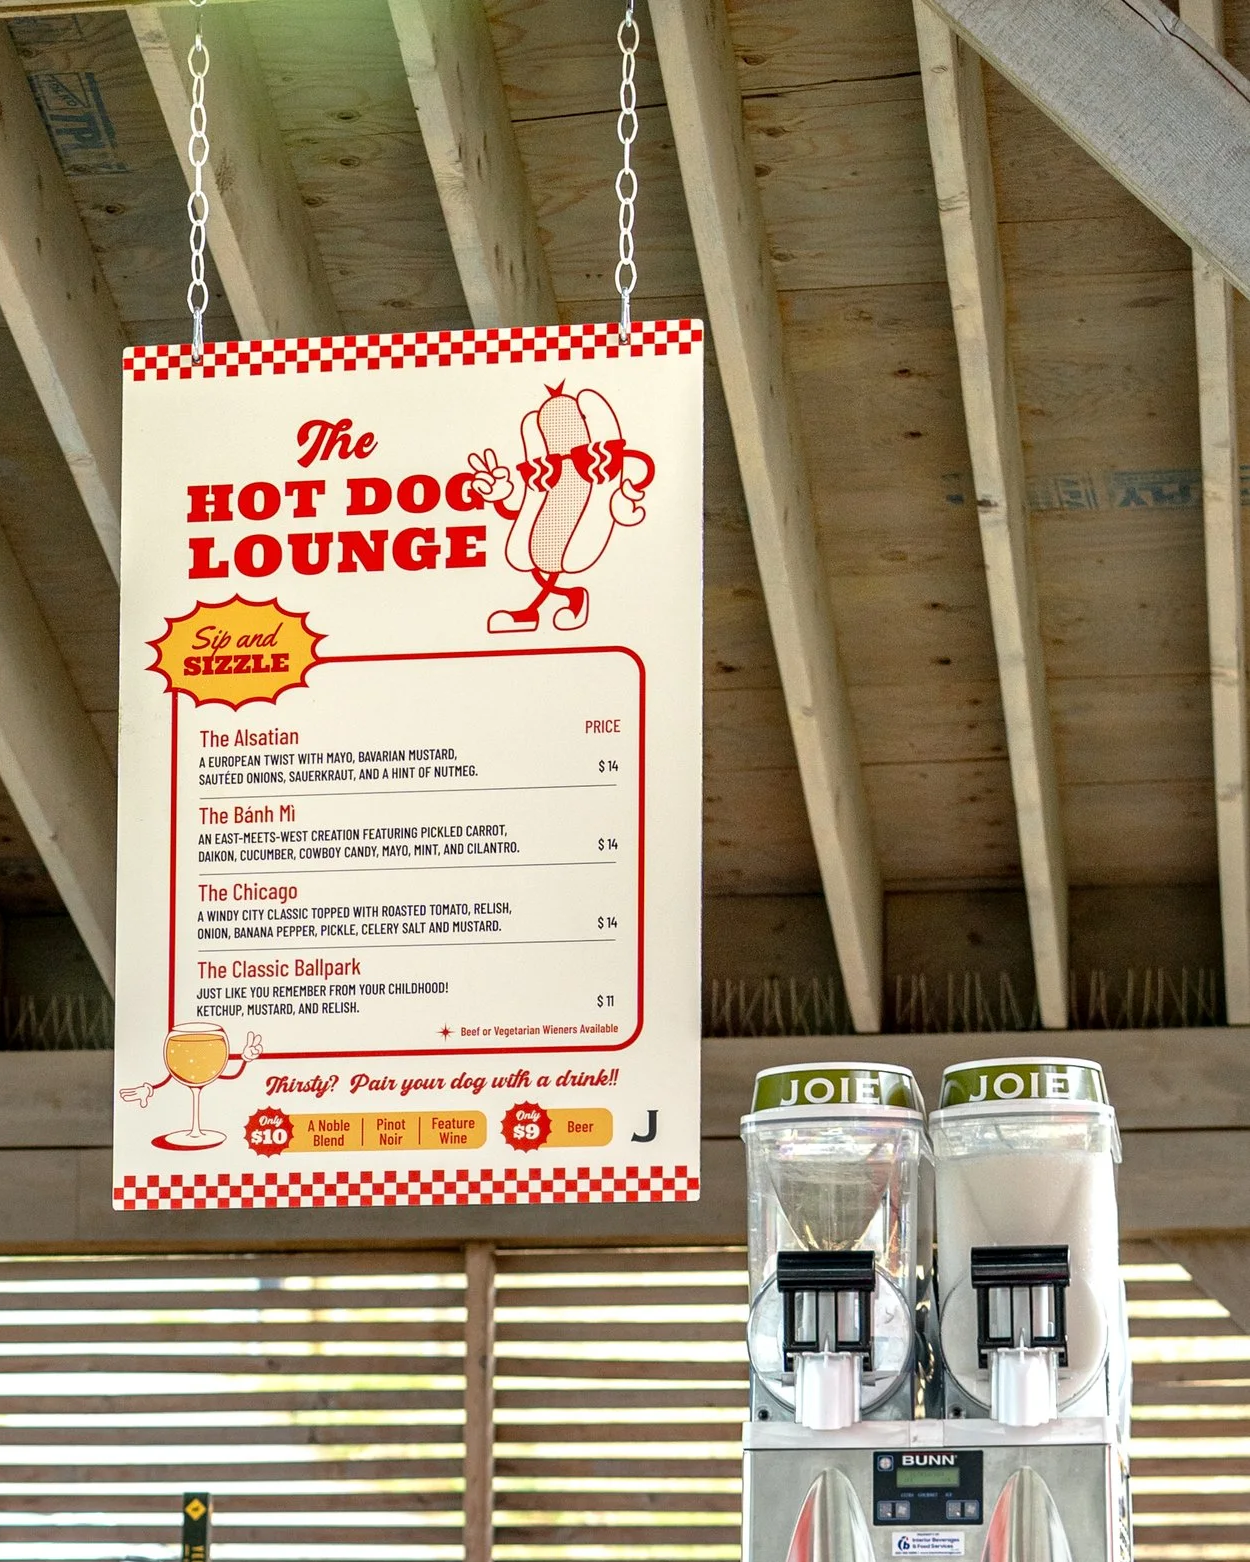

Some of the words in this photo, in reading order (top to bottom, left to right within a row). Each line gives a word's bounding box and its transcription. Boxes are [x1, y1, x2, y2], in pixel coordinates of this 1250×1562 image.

[296, 418, 379, 469] The
[186, 479, 326, 523] HOT
[346, 472, 485, 517] DOG
[188, 525, 487, 580] LOUNGE
[191, 625, 232, 656] Sip
[236, 622, 284, 648] and
[183, 653, 289, 676] SIZZLE
[585, 719, 620, 733] PRICE
[199, 730, 229, 747] The
[233, 727, 298, 746] Alsatian
[198, 756, 205, 768] A
[208, 754, 260, 768] EUROPEAN
[263, 753, 294, 765] TWIST
[297, 752, 323, 764] WITH
[326, 751, 355, 763] MAYO,
[358, 749, 405, 762] BAVARIAN
[408, 748, 457, 760] MUSTARD,
[598, 759, 605, 773] $
[607, 760, 618, 771] 14
[198, 770, 243, 785] SAUTÉED
[246, 771, 286, 783] ONIONS,
[288, 768, 356, 782] SAUERKRAUT,
[358, 768, 379, 779] AND
[381, 767, 388, 779] A
[391, 766, 415, 778] HINT
[418, 766, 431, 778] OF
[434, 764, 478, 777] NUTMEG.
[198, 807, 228, 824] The
[234, 805, 273, 823] Bánh
[279, 804, 294, 822] Mì
[197, 833, 211, 845] AN
[214, 830, 308, 844] EAST-MEETS-WEST
[311, 828, 359, 841] CREATION
[362, 826, 417, 839] FEATURING
[420, 825, 462, 838] PICKLED
[465, 824, 507, 836] CARROT,
[198, 850, 236, 862] DAIKON,
[239, 848, 296, 861] CUCUMBER,
[299, 846, 341, 859] COWBOY
[344, 845, 378, 858] CANDY,
[382, 844, 410, 857] MAYO,
[414, 843, 440, 856] MINT,
[443, 843, 463, 854] AND
[466, 841, 519, 854] CILANTRO.
[598, 837, 604, 851] $
[607, 838, 618, 849] 14
[198, 884, 227, 901] The
[233, 882, 297, 904] Chicago
[197, 910, 204, 922] A
[206, 909, 238, 921] WINDY
[241, 909, 264, 921] CITY
[267, 907, 308, 920] CLASSIC
[311, 906, 349, 918] TOPPED
[352, 905, 378, 917] WITH
[381, 904, 426, 917] ROASTED
[429, 903, 470, 915] TOMATO,
[473, 902, 511, 914] RELISH,
[197, 927, 230, 939] ONION,
[234, 926, 273, 938] BANANA
[276, 924, 317, 937] PEPPER,
[320, 923, 358, 936] PICKLE,
[361, 922, 399, 935] CELERY
[402, 921, 426, 934] SALT
[428, 921, 449, 933] AND
[452, 919, 501, 932] MUSTARD.
[597, 915, 603, 929] $
[606, 916, 617, 928] 14
[197, 961, 226, 979] The
[232, 959, 288, 978] Classic
[294, 957, 360, 980] Ballpark
[196, 987, 222, 999] JUST
[225, 986, 246, 998] LIKE
[249, 986, 269, 998] YOU
[272, 984, 326, 997] REMEMBER
[329, 984, 355, 996] FROM
[358, 983, 385, 995] YOUR
[388, 981, 448, 994] CHILDHOOD!
[196, 1004, 243, 1016] KETCHUP,
[247, 1003, 295, 1015] MUSTARD,
[297, 1002, 318, 1014] AND
[321, 1001, 359, 1013] RELISH.
[596, 994, 603, 1008] $
[606, 995, 613, 1006] 11
[460, 1026, 480, 1036] Beef
[482, 1028, 491, 1036] or
[493, 1025, 540, 1037] Vegetarian
[542, 1024, 577, 1034] Wieners
[579, 1023, 618, 1033] Available
[265, 1074, 339, 1098] Thirsty?
[349, 1073, 397, 1094] Pair
[399, 1077, 446, 1096] your
[450, 1071, 487, 1095] dog
[490, 1068, 532, 1088] with
[536, 1075, 551, 1087] a
[555, 1068, 619, 1087] drink!!
[780, 1077, 880, 1107] JOIE
[969, 1072, 1071, 1103] JOIE
[258, 1115, 284, 1127] Only
[376, 1118, 406, 1131] Pinot
[431, 1117, 475, 1130] Feature
[515, 1109, 541, 1122] Only
[307, 1120, 315, 1132] A
[318, 1119, 350, 1132] Noble
[513, 1123, 541, 1140] $9
[567, 1120, 594, 1133] Beer
[630, 1109, 659, 1143] J
[251, 1128, 288, 1145] $10
[313, 1133, 345, 1147] Blend
[379, 1133, 403, 1146] Noir
[439, 1131, 467, 1145] Wine
[902, 1455, 955, 1466] BUNN
